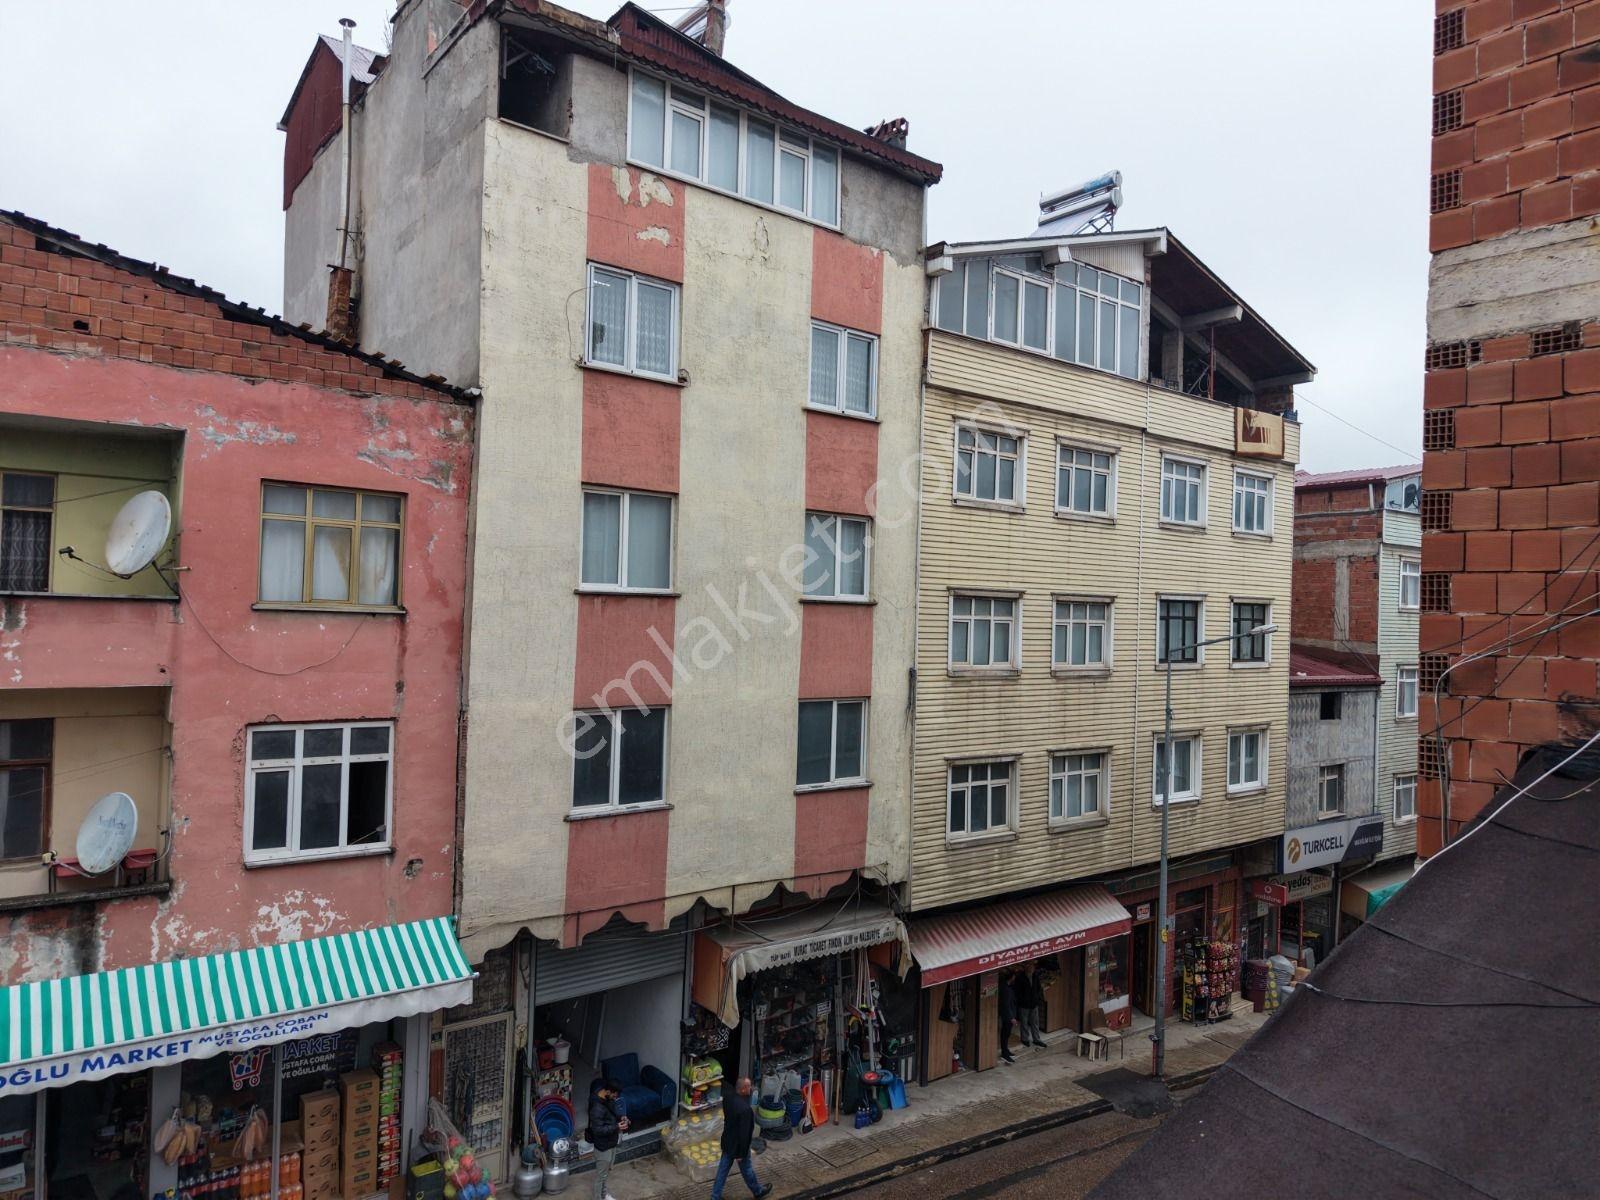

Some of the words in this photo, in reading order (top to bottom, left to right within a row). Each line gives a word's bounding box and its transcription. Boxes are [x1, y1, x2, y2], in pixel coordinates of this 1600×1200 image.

[1303, 836, 1344, 855] TURKCELL
[1255, 893, 1282, 904] vodafone
[793, 944, 808, 956] MURAT
[810, 939, 826, 953] TİCARET
[979, 941, 1051, 965] DİYAMAR
[1055, 931, 1086, 945] AVM
[199, 1025, 270, 1044] MUSTAFA
[276, 1012, 329, 1029] ÇOBAN
[80, 1040, 192, 1073] MARKET
[281, 1057, 309, 1071] USTAFA
[309, 1053, 335, 1066] ÇOBAN
[281, 1070, 291, 1079] VE
